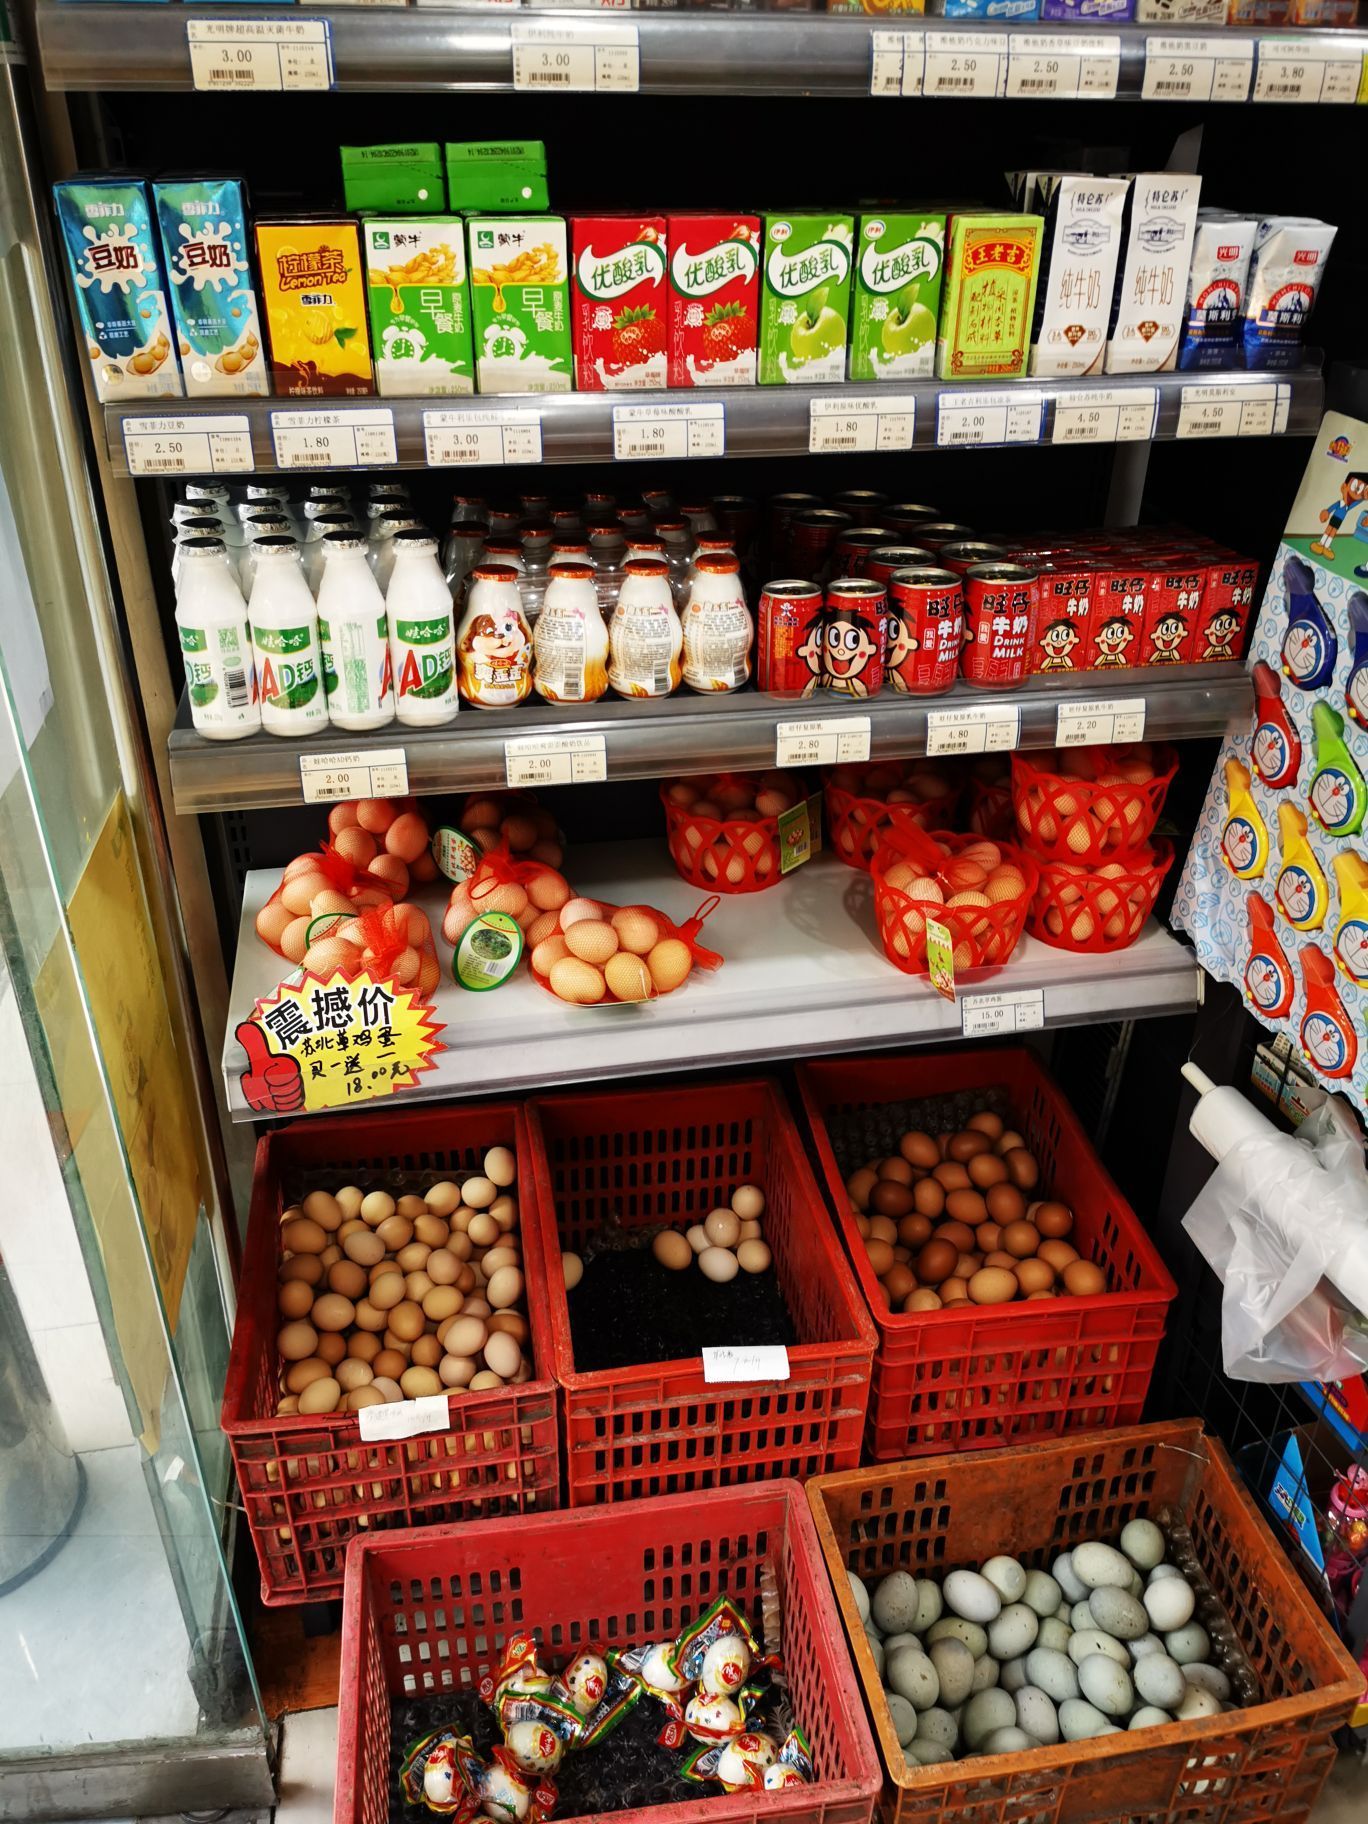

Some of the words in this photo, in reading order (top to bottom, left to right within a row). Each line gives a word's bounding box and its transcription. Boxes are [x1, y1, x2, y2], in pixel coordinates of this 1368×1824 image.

[222, 49, 252, 63] 3.00
[542, 53, 570, 66] 3.00
[951, 59, 977, 72] 2.50
[1034, 61, 1058, 73] 2.50
[1169, 63, 1193, 76] 2.50
[1280, 66, 1304, 78] 3.80
[1077, 191, 1105, 205] 特仑苏
[1152, 189, 1180, 203] 特仑苏
[867, 225, 882, 235] 伊利
[393, 233, 421, 248] 蒙牛
[498, 233, 525, 247] 蒙牛
[88, 242, 138, 271] 豆奶
[182, 241, 231, 270] 豆奶
[976, 244, 1020, 264] 王老吉
[1219, 247, 1239, 258] 光明
[1296, 250, 1317, 262] 光明
[277, 249, 345, 276] 柠檬茶
[592, 248, 654, 291] 优酸乳
[685, 247, 746, 289] 优酸乳
[780, 247, 839, 289] 优酸乳
[872, 243, 930, 285] 优酸乳
[279, 274, 323, 291] Lemon
[325, 270, 347, 285] Tea
[1135, 265, 1174, 305] 纯牛奶
[1059, 269, 1102, 311] 纯牛奶
[420, 289, 455, 334] 早餐
[522, 288, 554, 333] 早餐
[1077, 412, 1100, 423] 4.50
[1202, 407, 1223, 418] 4.50
[139, 420, 185, 431] 雪菲力豆奶
[287, 415, 341, 426] 雪菲力柠檬茶
[836, 421, 858, 432] 1.80
[962, 415, 985, 427] 2.00
[453, 434, 479, 445] 3.00
[641, 427, 665, 439] 1.80
[154, 442, 182, 454] 2.50
[303, 437, 329, 448] 1.80
[1165, 574, 1200, 590] 旺仔
[1222, 569, 1255, 586] 旺仔
[1054, 579, 1090, 596] 旺仔
[1110, 577, 1145, 594] 旺仔
[983, 592, 1031, 614] 旺仔
[1177, 591, 1200, 610] 牛奶
[1231, 587, 1252, 606] 牛奶
[1066, 597, 1089, 616] 牛奶
[1122, 594, 1144, 614] 牛奶
[405, 624, 444, 639] 娃哈哈
[992, 616, 1029, 635] 牛奶
[261, 634, 302, 648] 娃哈哈
[262, 656, 314, 705] AD钙
[1076, 720, 1097, 731] 2.20
[948, 730, 969, 740] 4.80
[798, 740, 820, 750] 2.80
[528, 759, 551, 770] 2.00
[326, 774, 350, 784] 2.00
[264, 986, 394, 1050] 震撼价
[981, 1009, 1004, 1020] 15.00
[300, 1026, 402, 1057] 苏北草鸡蛋
[346, 1061, 410, 1096] 18.00元
